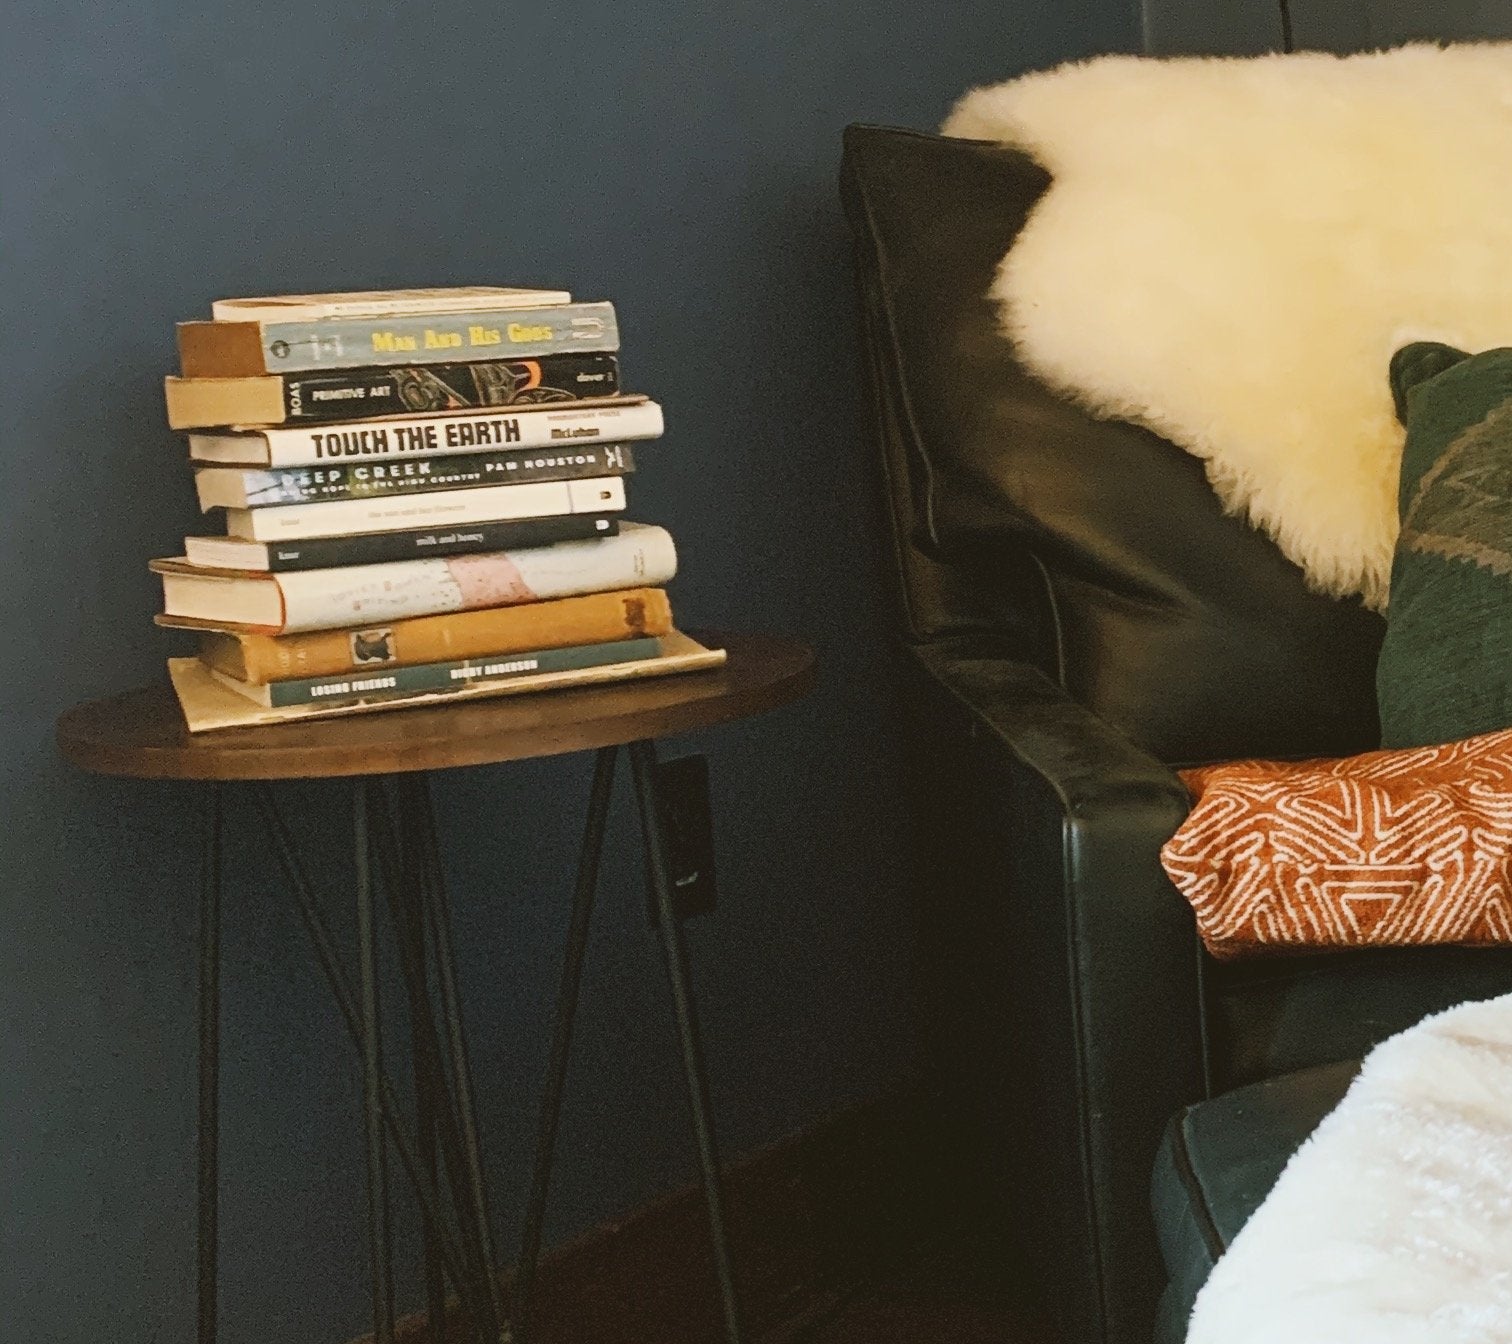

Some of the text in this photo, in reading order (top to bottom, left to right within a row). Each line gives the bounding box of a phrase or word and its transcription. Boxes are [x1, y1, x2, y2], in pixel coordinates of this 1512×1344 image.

[289, 382, 302, 416] BOAS
[312, 384, 392, 402] PRIMITIVE ART
[311, 419, 521, 458] TOUCH THE EARTH
[354, 462, 431, 481] CREEK
[524, 454, 597, 470] HOUSTON
